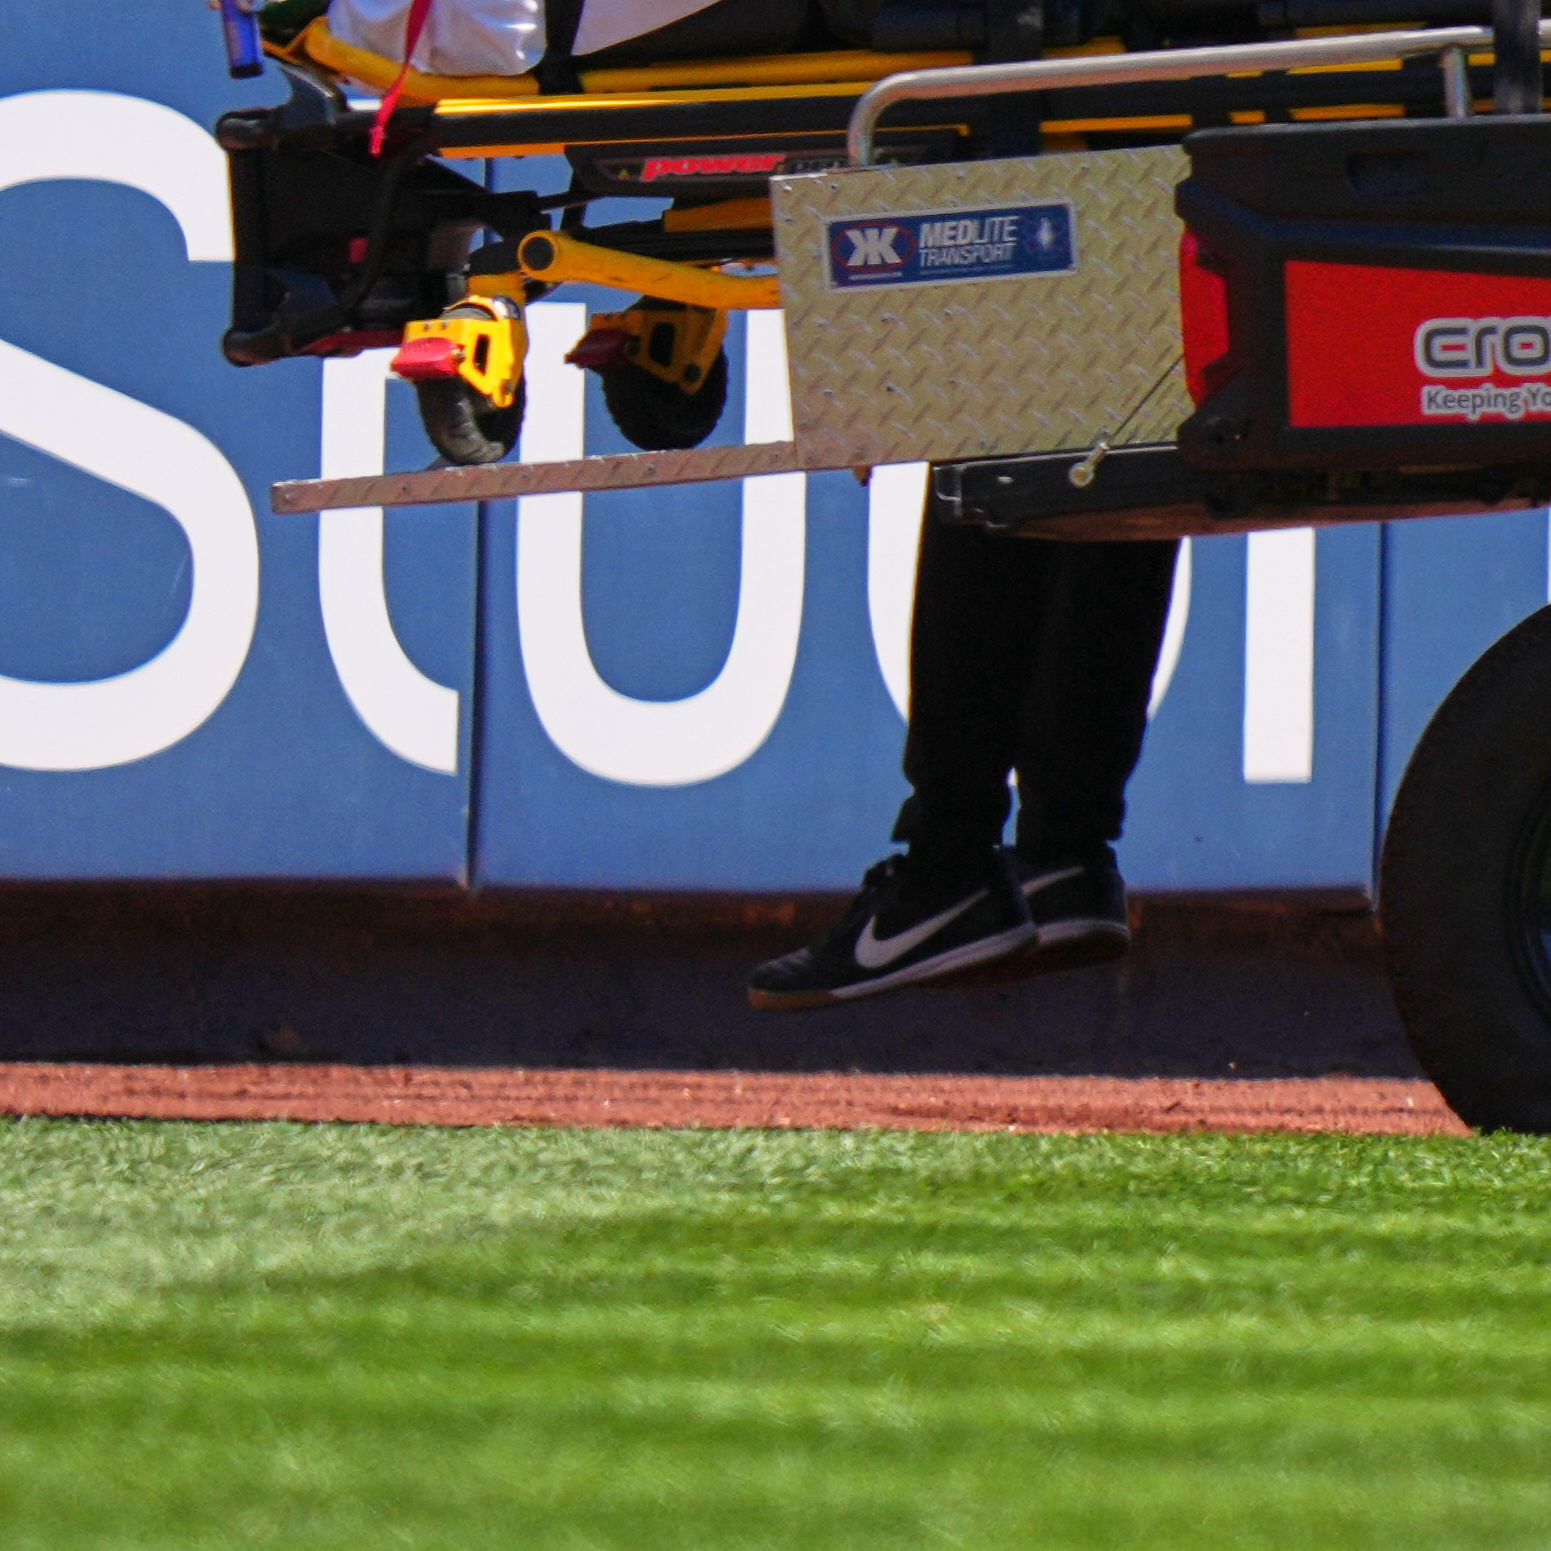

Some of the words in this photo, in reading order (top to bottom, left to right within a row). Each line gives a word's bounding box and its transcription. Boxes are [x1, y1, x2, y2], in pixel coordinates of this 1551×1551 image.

[919, 215, 1021, 248] MEDLITE
[919, 243, 1016, 268] TRANSPORT
[1427, 386, 1521, 416] Keeping
